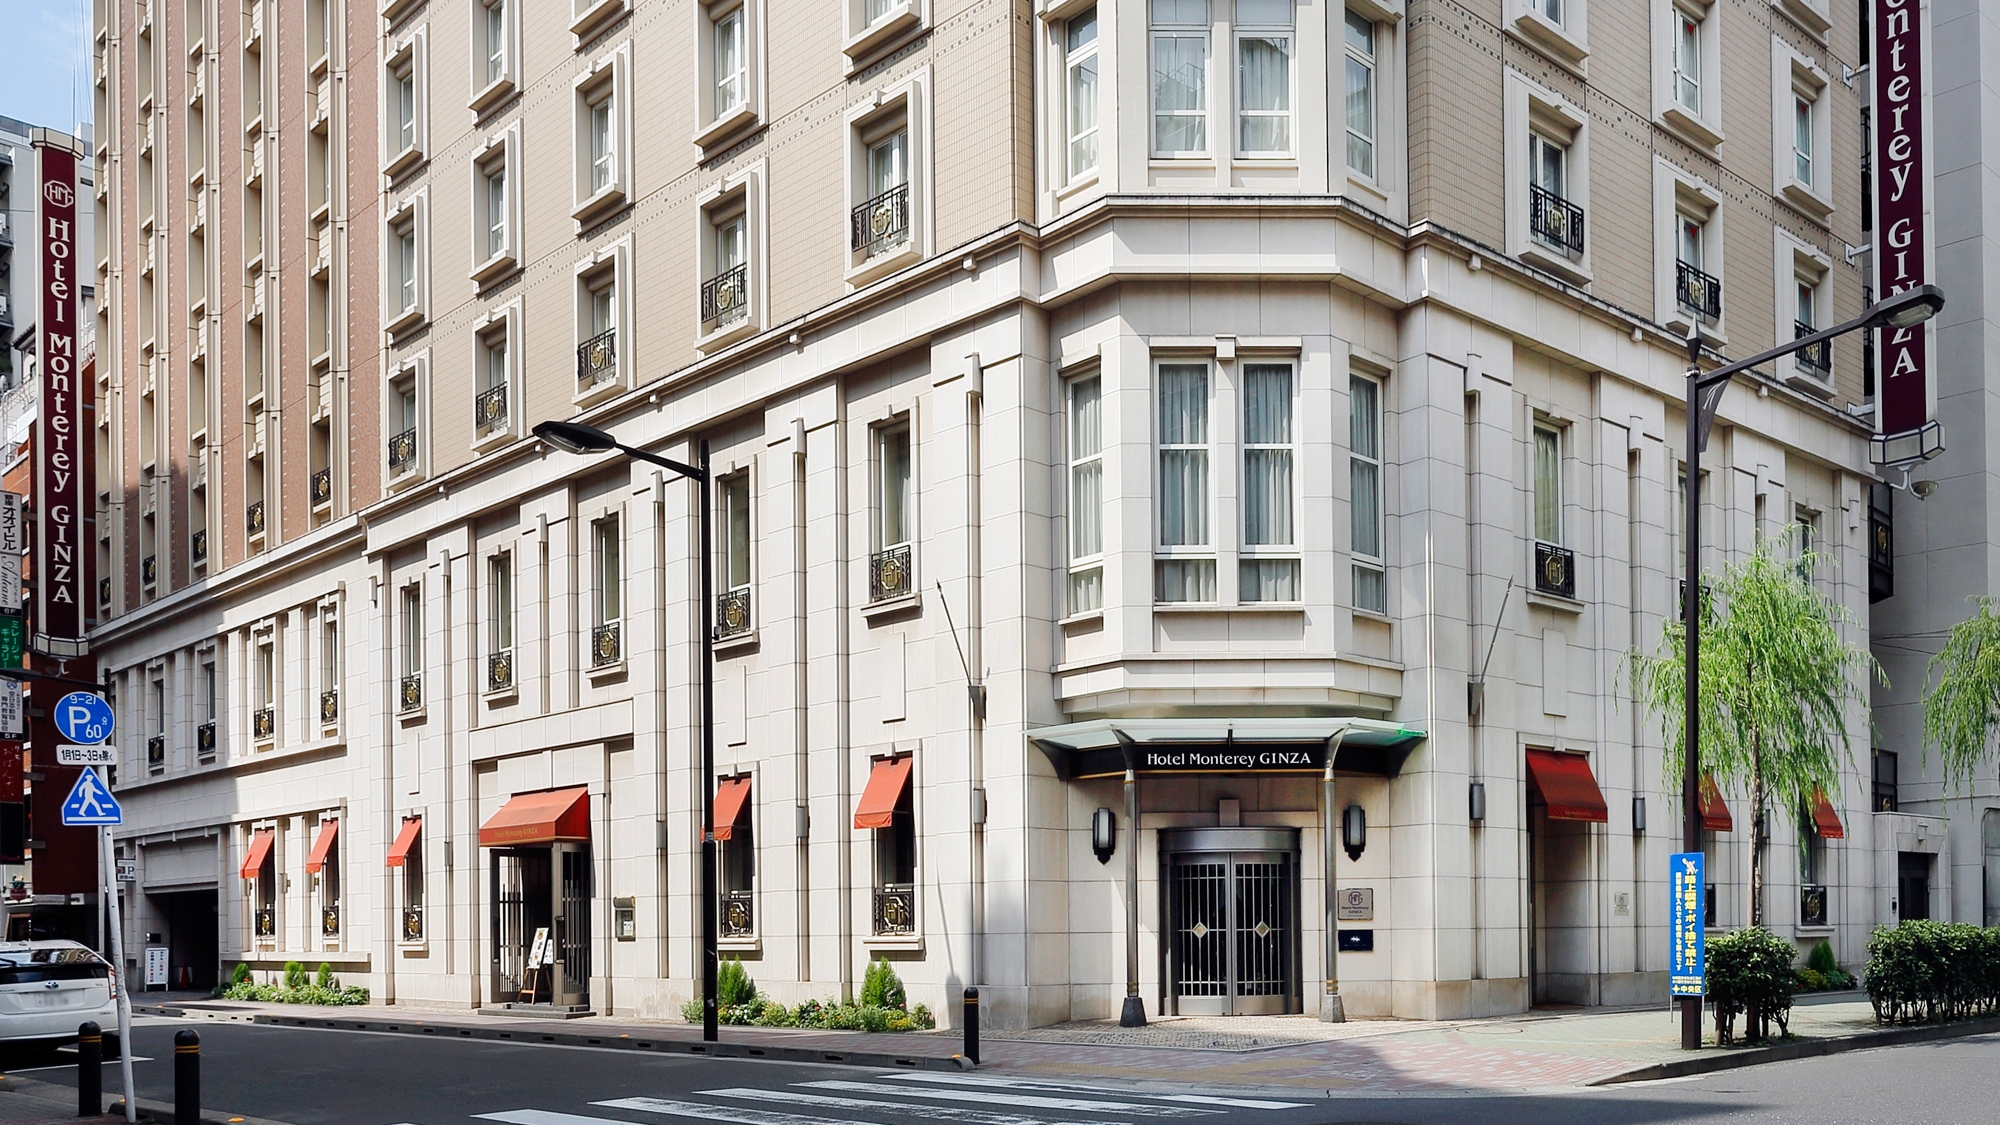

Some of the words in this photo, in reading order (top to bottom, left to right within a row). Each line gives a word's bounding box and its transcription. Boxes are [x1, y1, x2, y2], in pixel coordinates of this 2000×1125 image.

[48, 216, 70, 323] Hotel
[49, 332, 73, 493] Monterey
[51, 505, 73, 604] GINZA
[68, 706, 91, 738] P
[69, 694, 97, 705] 9-21
[1147, 753, 1185, 765] Hotel
[1190, 753, 1256, 767] Monterey
[1259, 752, 1311, 764] GINZA
